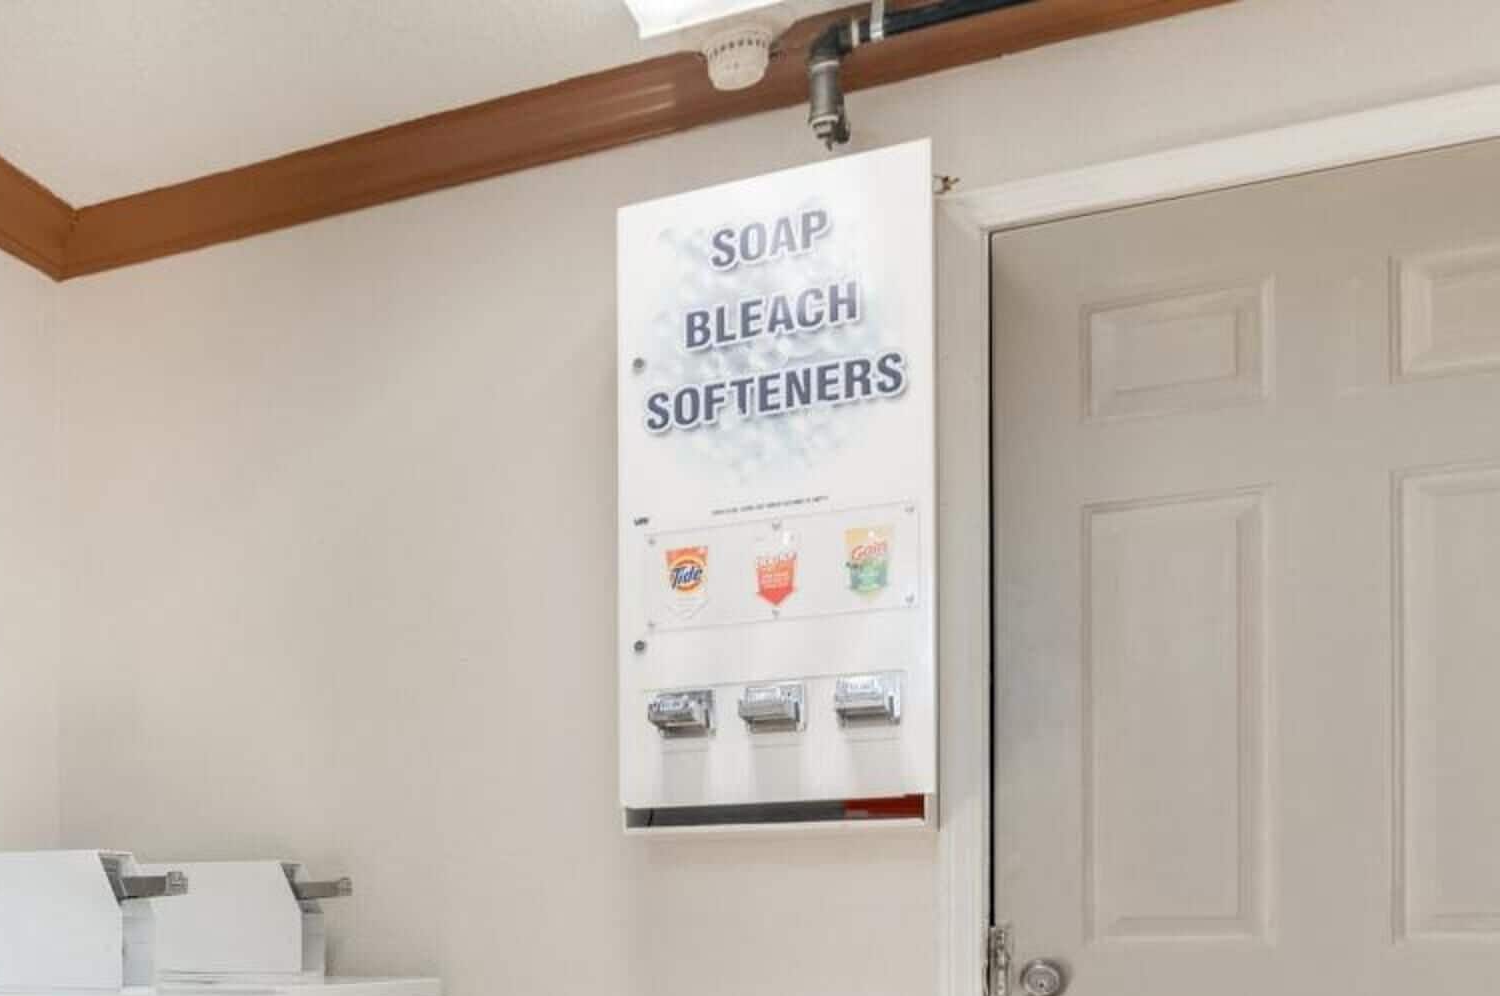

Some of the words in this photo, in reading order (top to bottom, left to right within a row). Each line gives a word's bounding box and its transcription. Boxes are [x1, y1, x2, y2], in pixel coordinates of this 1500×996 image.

[711, 209, 828, 268] SOAP
[685, 281, 858, 349] BLEACH
[646, 352, 904, 431] SOFTENERS
[669, 565, 703, 590] Tide
